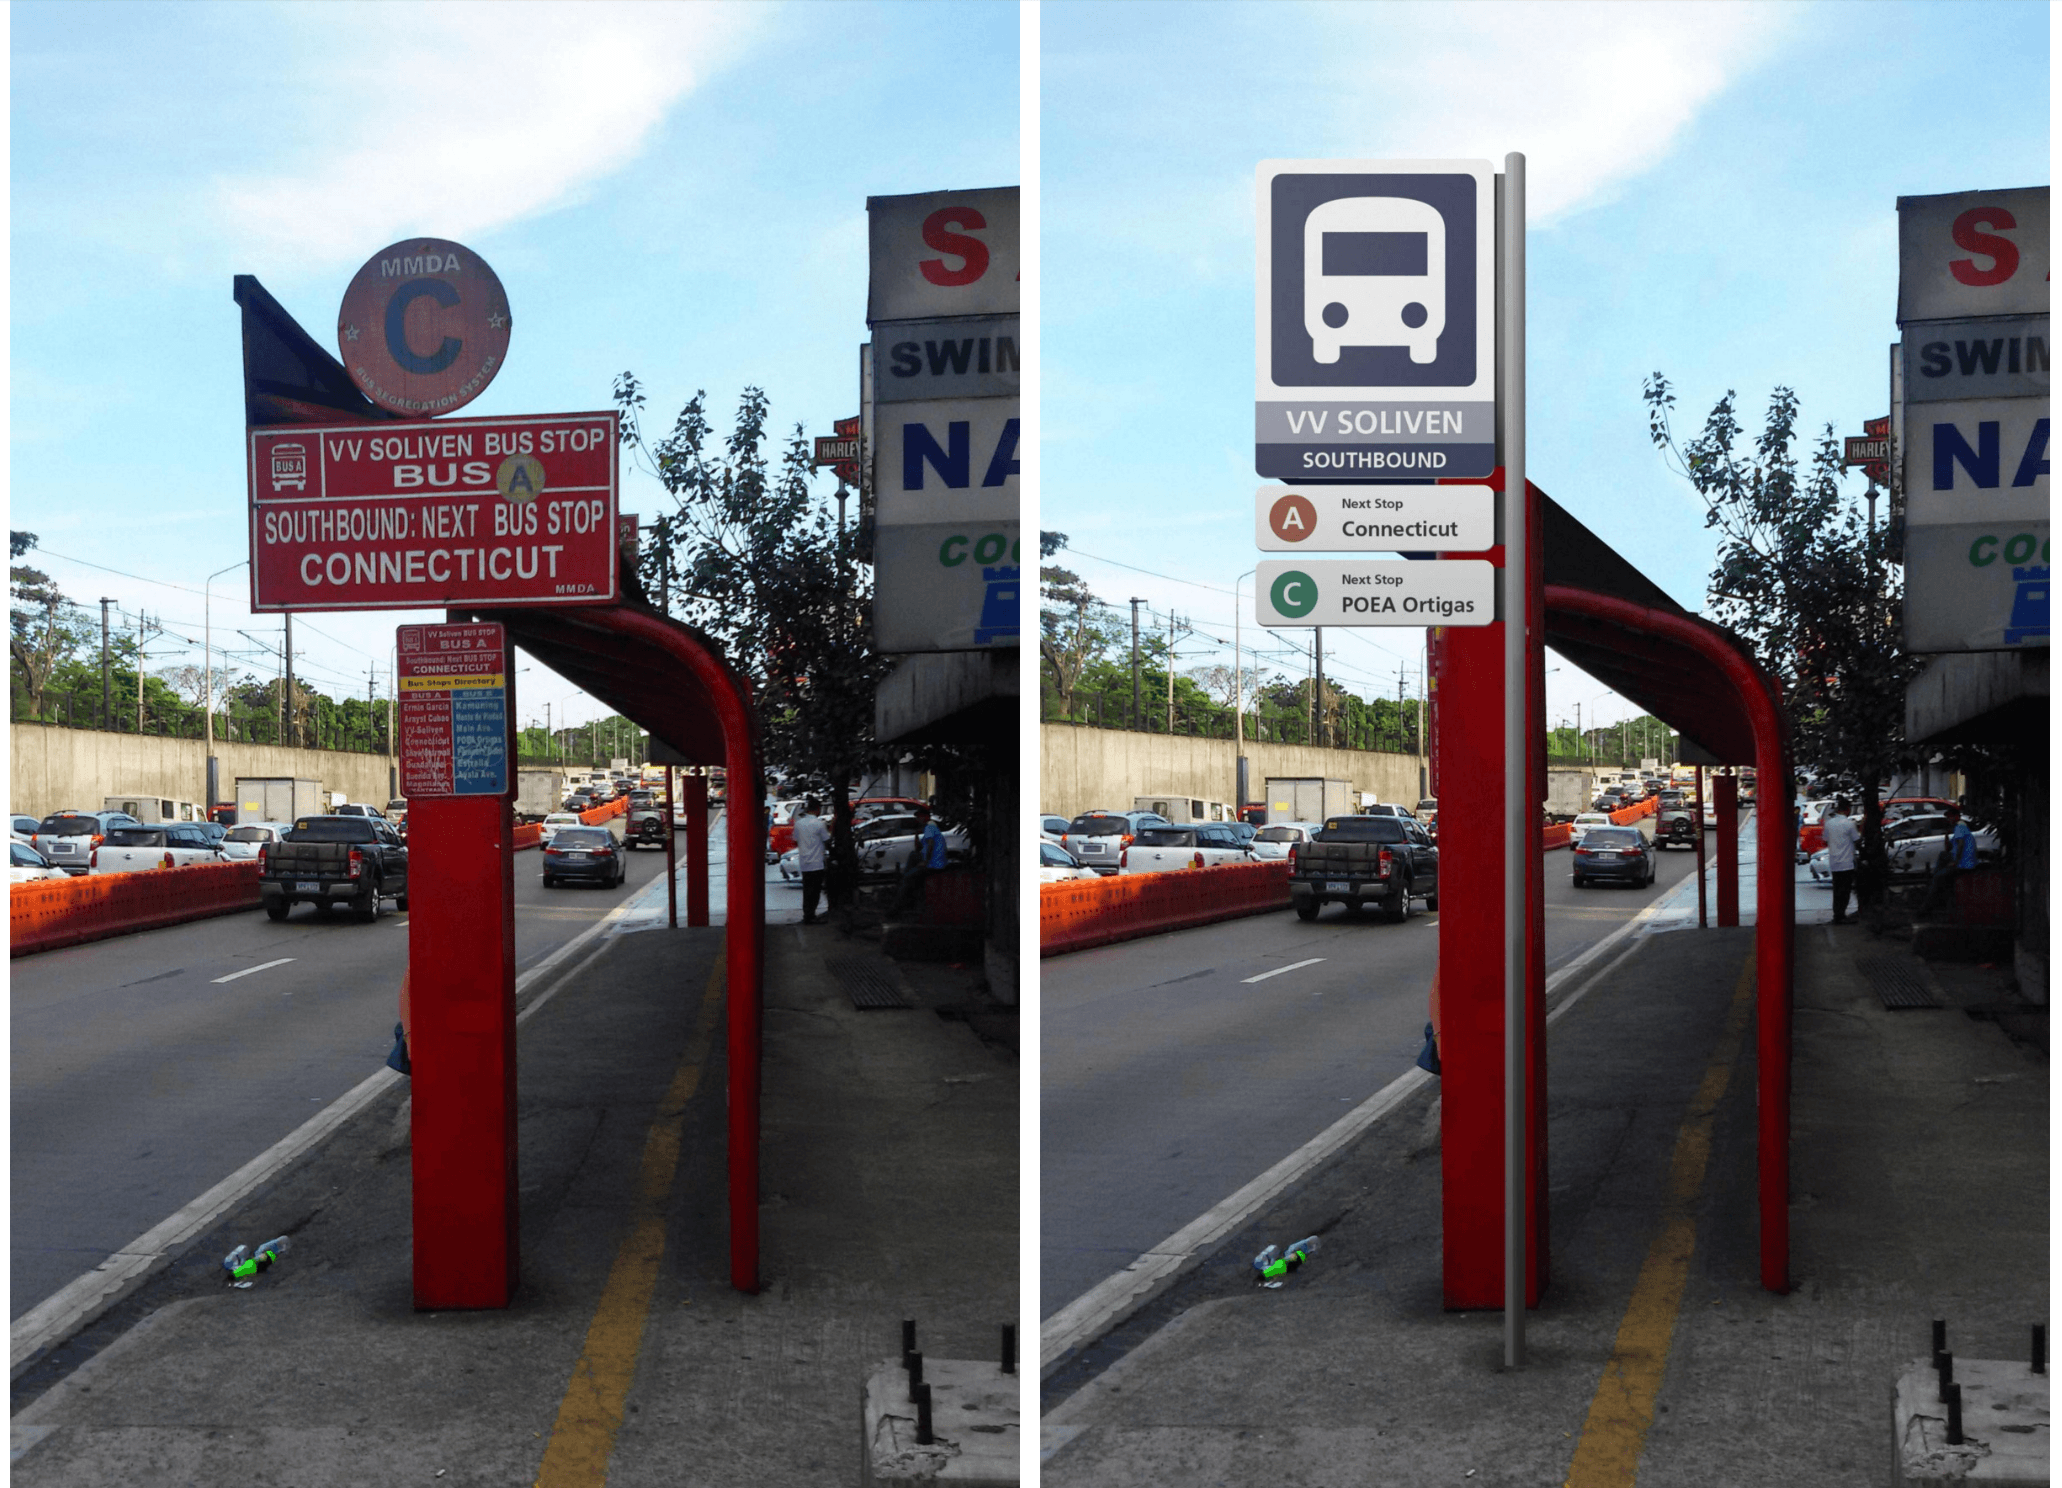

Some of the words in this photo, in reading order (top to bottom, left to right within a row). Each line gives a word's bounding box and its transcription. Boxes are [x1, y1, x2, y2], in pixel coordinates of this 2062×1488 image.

[918, 206, 1020, 287] S
[1948, 206, 2050, 287] S
[381, 253, 461, 277] MMDA
[384, 277, 463, 375] C
[356, 367, 375, 391] BUS
[459, 355, 496, 397] SYSTEM
[1285, 410, 1328, 434] VV
[1337, 410, 1463, 434] SOLIVEN
[329, 439, 363, 462] VV
[370, 435, 473, 461] SOLIVEN
[485, 431, 533, 456] BUS
[539, 428, 605, 453] STOP
[275, 461, 294, 473] BUS
[295, 460, 303, 472] A
[1302, 452, 1447, 468] SOUTHBOUND
[393, 461, 492, 488] BUS
[508, 465, 534, 494] A
[1342, 499, 1371, 509] Next
[1374, 498, 1404, 511] Stop
[265, 505, 417, 545] SOUTHBOUND:
[422, 504, 480, 539] NEXT
[494, 502, 538, 537] BUS
[547, 500, 605, 535] STOP
[1282, 506, 1305, 530] A
[1342, 521, 1458, 537] Connecticut
[300, 544, 564, 587] CONNECTICUT
[555, 583, 595, 594] MMDA
[1342, 574, 1371, 585] Next
[1374, 574, 1404, 587] Stop
[1283, 582, 1302, 606] C
[1342, 597, 1396, 613] POEA
[1403, 596, 1475, 616] Ortigas
[464, 629, 477, 637] BUS
[478, 628, 496, 636] STOP
[440, 639, 471, 649] BUS
[476, 638, 487, 648] A
[464, 654, 479, 662] BUS
[480, 653, 496, 661] STOP
[413, 663, 490, 674] CONNECTICUT
[427, 680, 451, 688] Stops
[454, 678, 496, 686] Directory
[426, 703, 449, 711] Garcia
